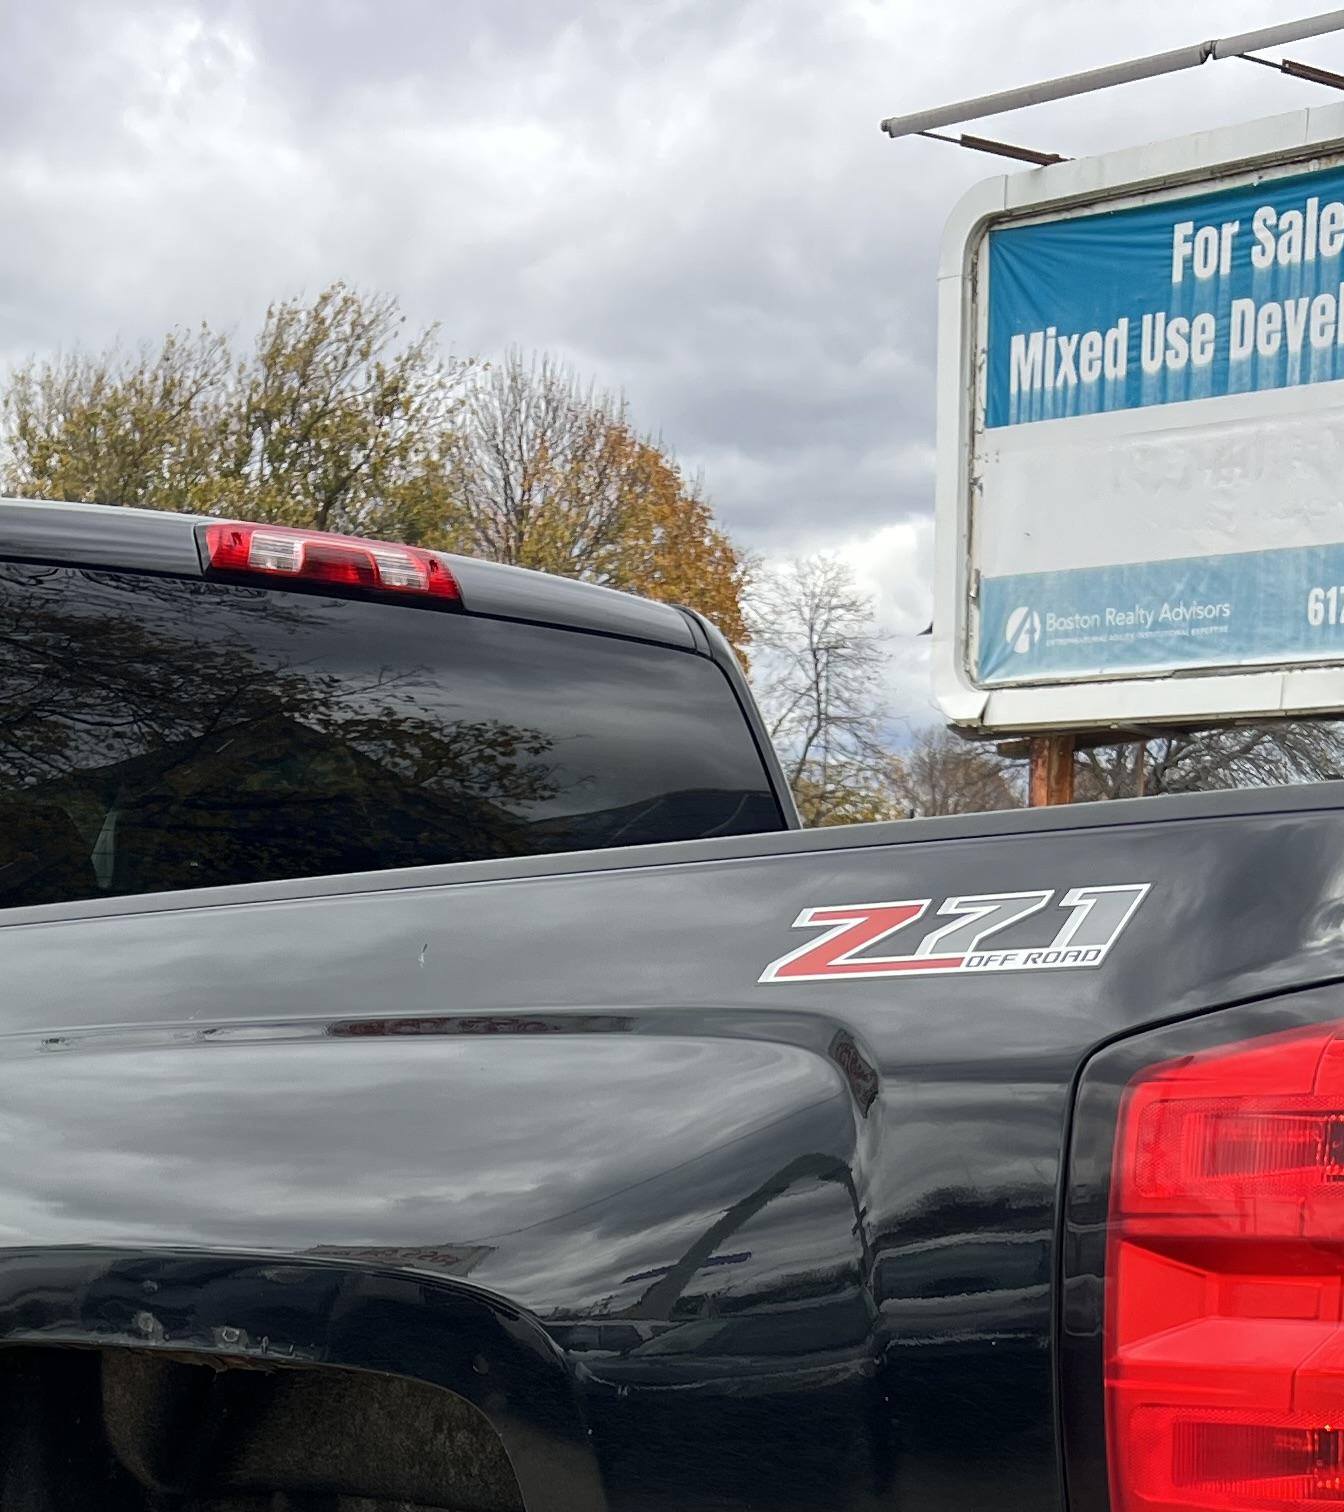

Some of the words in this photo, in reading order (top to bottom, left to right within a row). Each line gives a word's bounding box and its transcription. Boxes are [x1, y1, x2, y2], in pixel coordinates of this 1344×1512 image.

[1171, 221, 1239, 284] For
[1010, 317, 1128, 394] Mixed
[1140, 311, 1215, 373] Use
[1046, 612, 1100, 632] Boston
[1106, 605, 1154, 628] Realty
[1159, 601, 1231, 622] Advisors
[757, 883, 1152, 983] Z71
[965, 952, 1016, 968] OFF
[1024, 947, 1101, 966] ROAD
